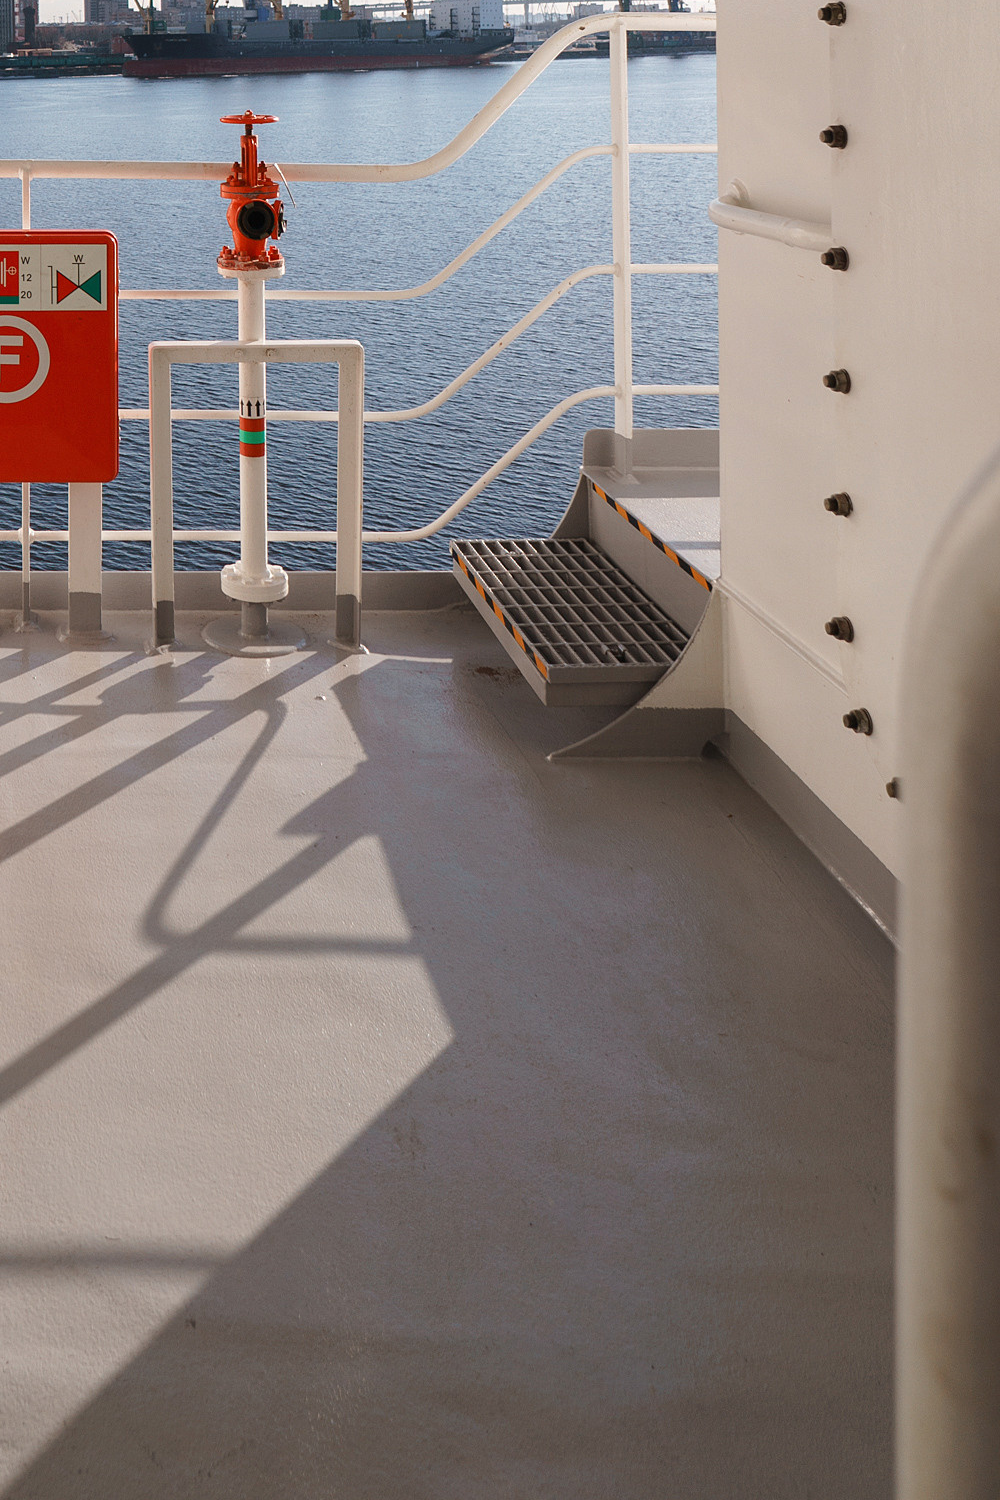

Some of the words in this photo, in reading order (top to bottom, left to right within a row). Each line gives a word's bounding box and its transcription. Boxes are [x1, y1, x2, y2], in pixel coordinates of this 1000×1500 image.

[20, 256, 30, 264] W
[73, 254, 84, 263] W
[21, 274, 32, 282] 12
[20, 291, 32, 299] 20
